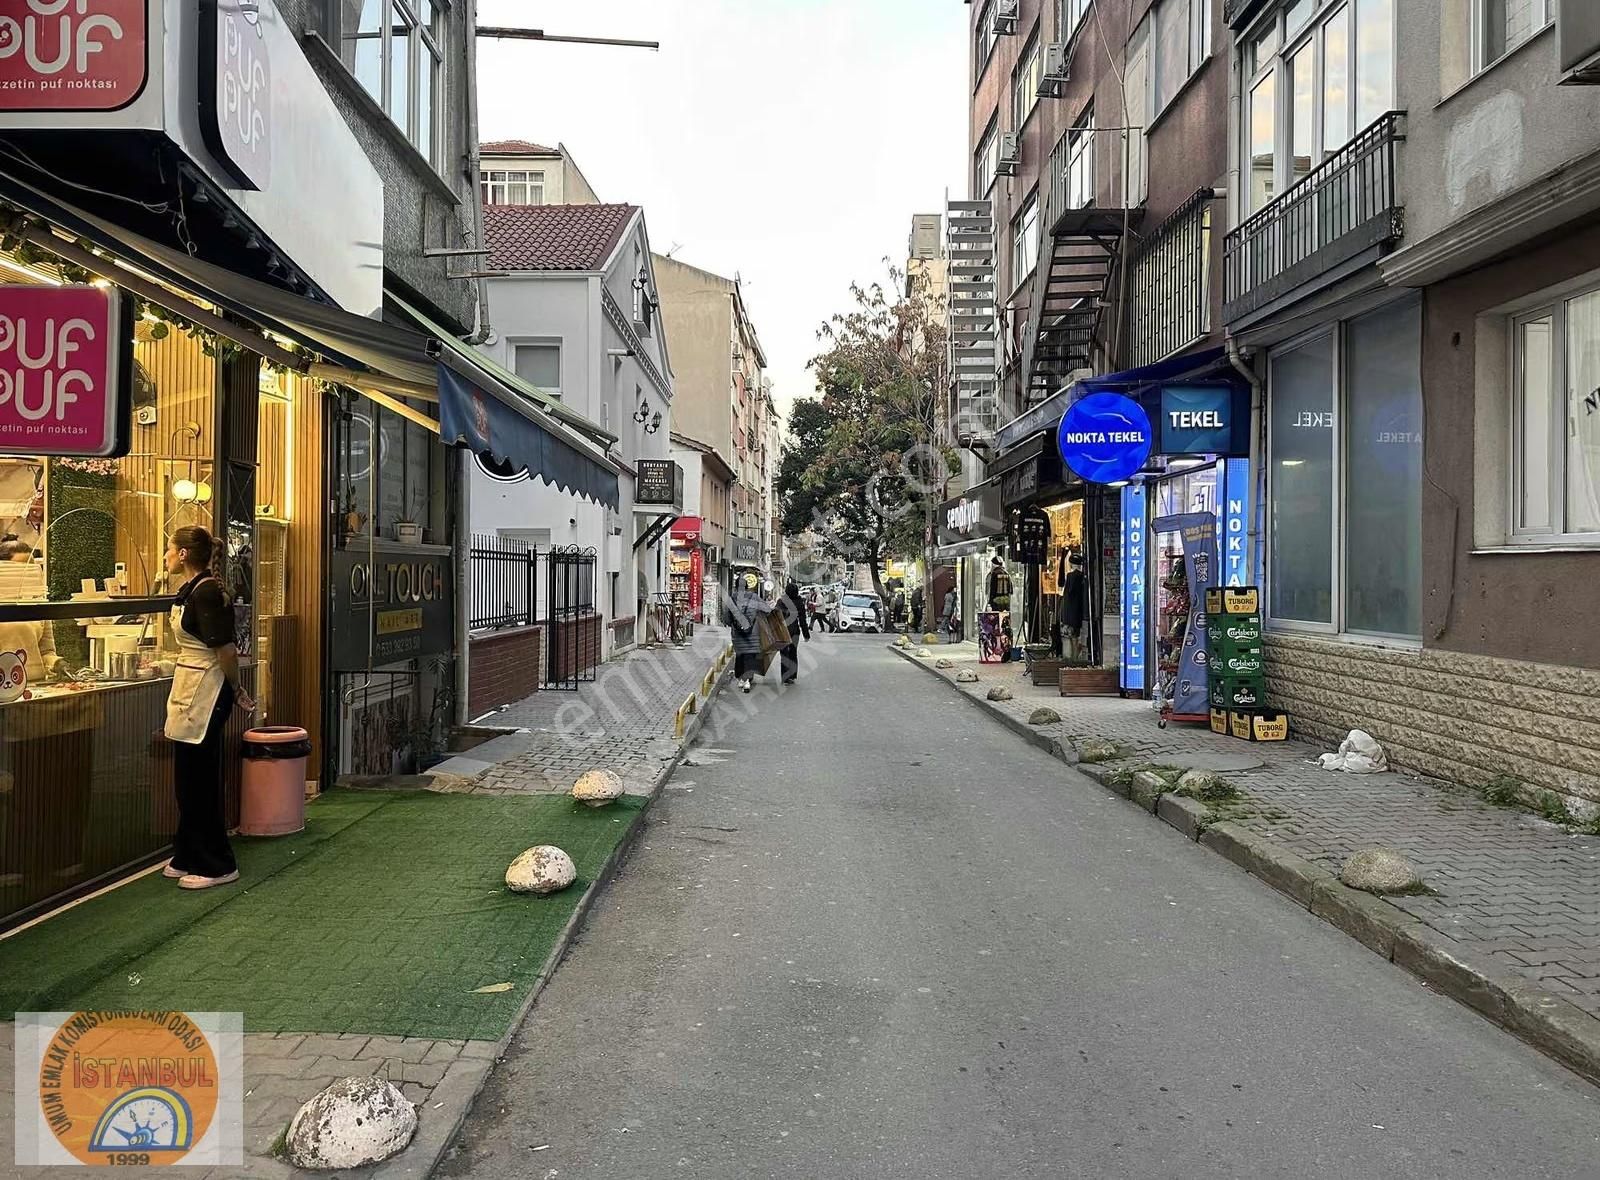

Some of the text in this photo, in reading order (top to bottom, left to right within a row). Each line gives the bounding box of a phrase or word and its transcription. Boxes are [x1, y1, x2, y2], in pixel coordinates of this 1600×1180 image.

[40, 78, 63, 92] puf
[1170, 411, 1223, 428] TEKEL
[26, 425, 44, 435] puf
[1067, 431, 1145, 444] NOKTA TEKEL
[1228, 500, 1243, 588] NOKTA
[385, 562, 443, 605] TOUCH
[1129, 517, 1142, 658] NOKTA TEKEL
[1228, 597, 1254, 605] TUBORG
[1227, 627, 1259, 640] Carlsberg
[1228, 658, 1260, 671] Carlsberg
[1233, 693, 1256, 704] Carlsberg
[1257, 724, 1284, 732] TUBORG
